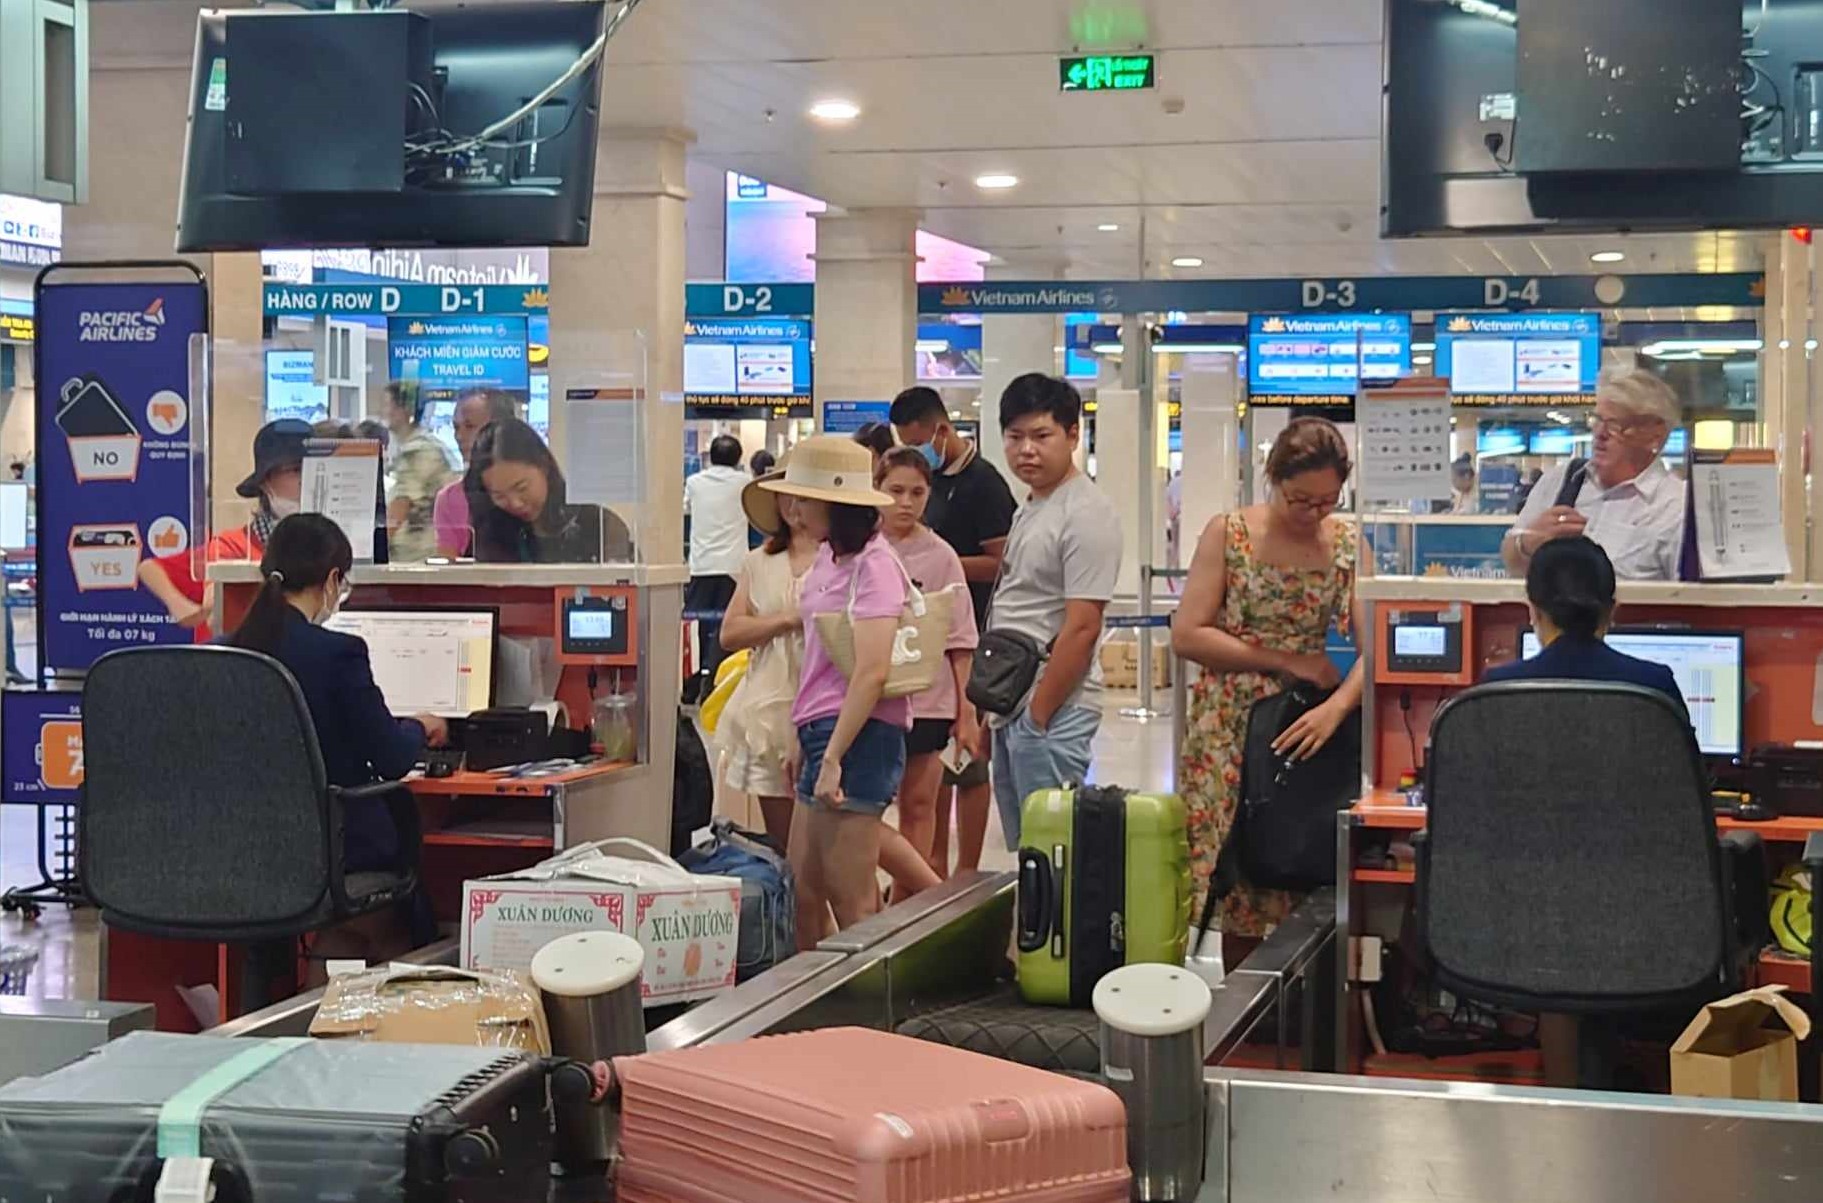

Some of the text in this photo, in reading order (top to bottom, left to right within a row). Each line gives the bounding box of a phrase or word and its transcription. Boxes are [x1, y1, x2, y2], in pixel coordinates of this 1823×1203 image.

[268, 287, 400, 312] HÀNG / ROW D
[441, 287, 484, 312] D-1
[723, 286, 771, 312] D-2
[1302, 281, 1356, 307] D-3
[1484, 279, 1540, 305] D-4
[79, 311, 143, 327] PACIFIC
[80, 327, 157, 341] AIRLINES
[433, 364, 469, 376] TRAVEL
[93, 451, 119, 465] NO
[91, 562, 122, 576] YES
[124, 628, 138, 640] 07
[141, 628, 155, 642] kg
[497, 904, 537, 922] XUÂN
[652, 910, 690, 942] XUÂN
